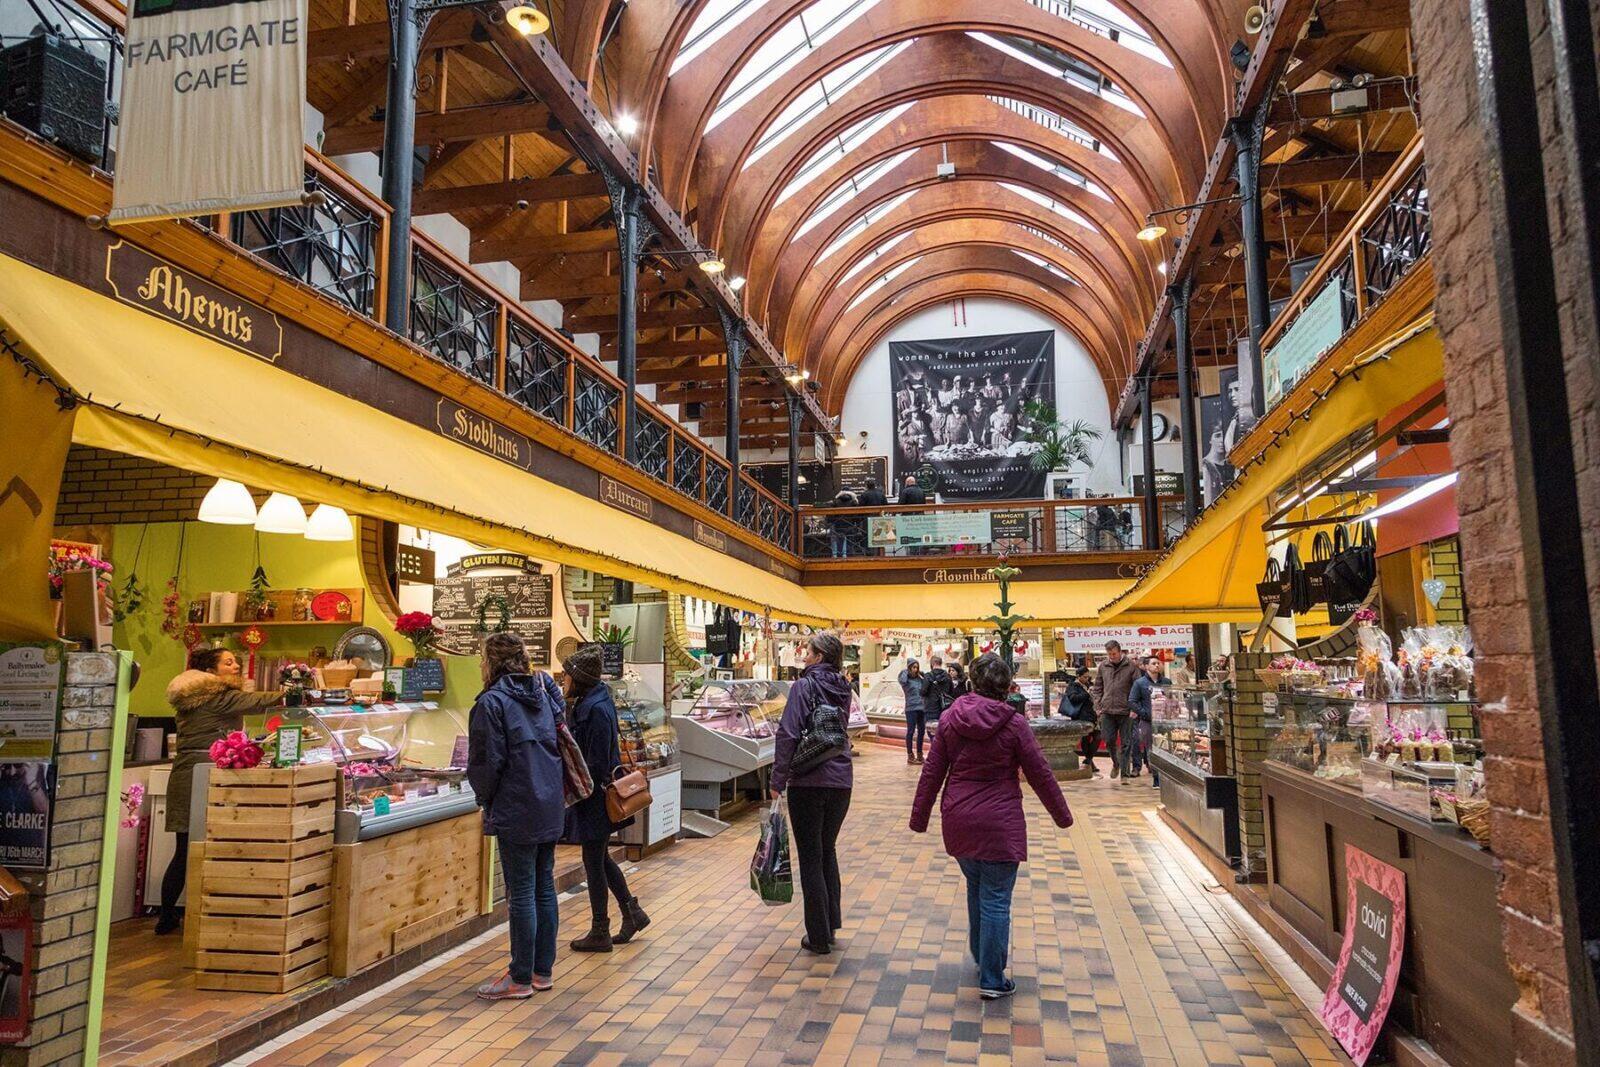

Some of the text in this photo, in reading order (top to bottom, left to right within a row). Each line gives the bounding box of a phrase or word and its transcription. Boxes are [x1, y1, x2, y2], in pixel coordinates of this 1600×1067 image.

[127, 17, 299, 69] FARMGATE
[174, 58, 248, 94] CAFÉ
[137, 265, 253, 343] Ahern's
[898, 346, 1017, 362] women of the south
[983, 357, 1047, 367] revolutionaries
[452, 408, 519, 461] Siobhan's
[963, 466, 993, 475] english
[607, 481, 649, 514] Durcan
[401, 553, 421, 575] ESS
[462, 555, 524, 568] GLUTEN FREE
[887, 630, 923, 640] POULTRY
[1067, 629, 1133, 638] STEPHEN'S
[5, 811, 45, 829] CLARKE
[21, 846, 45, 858] MARCH
[1361, 902, 1387, 940] david
